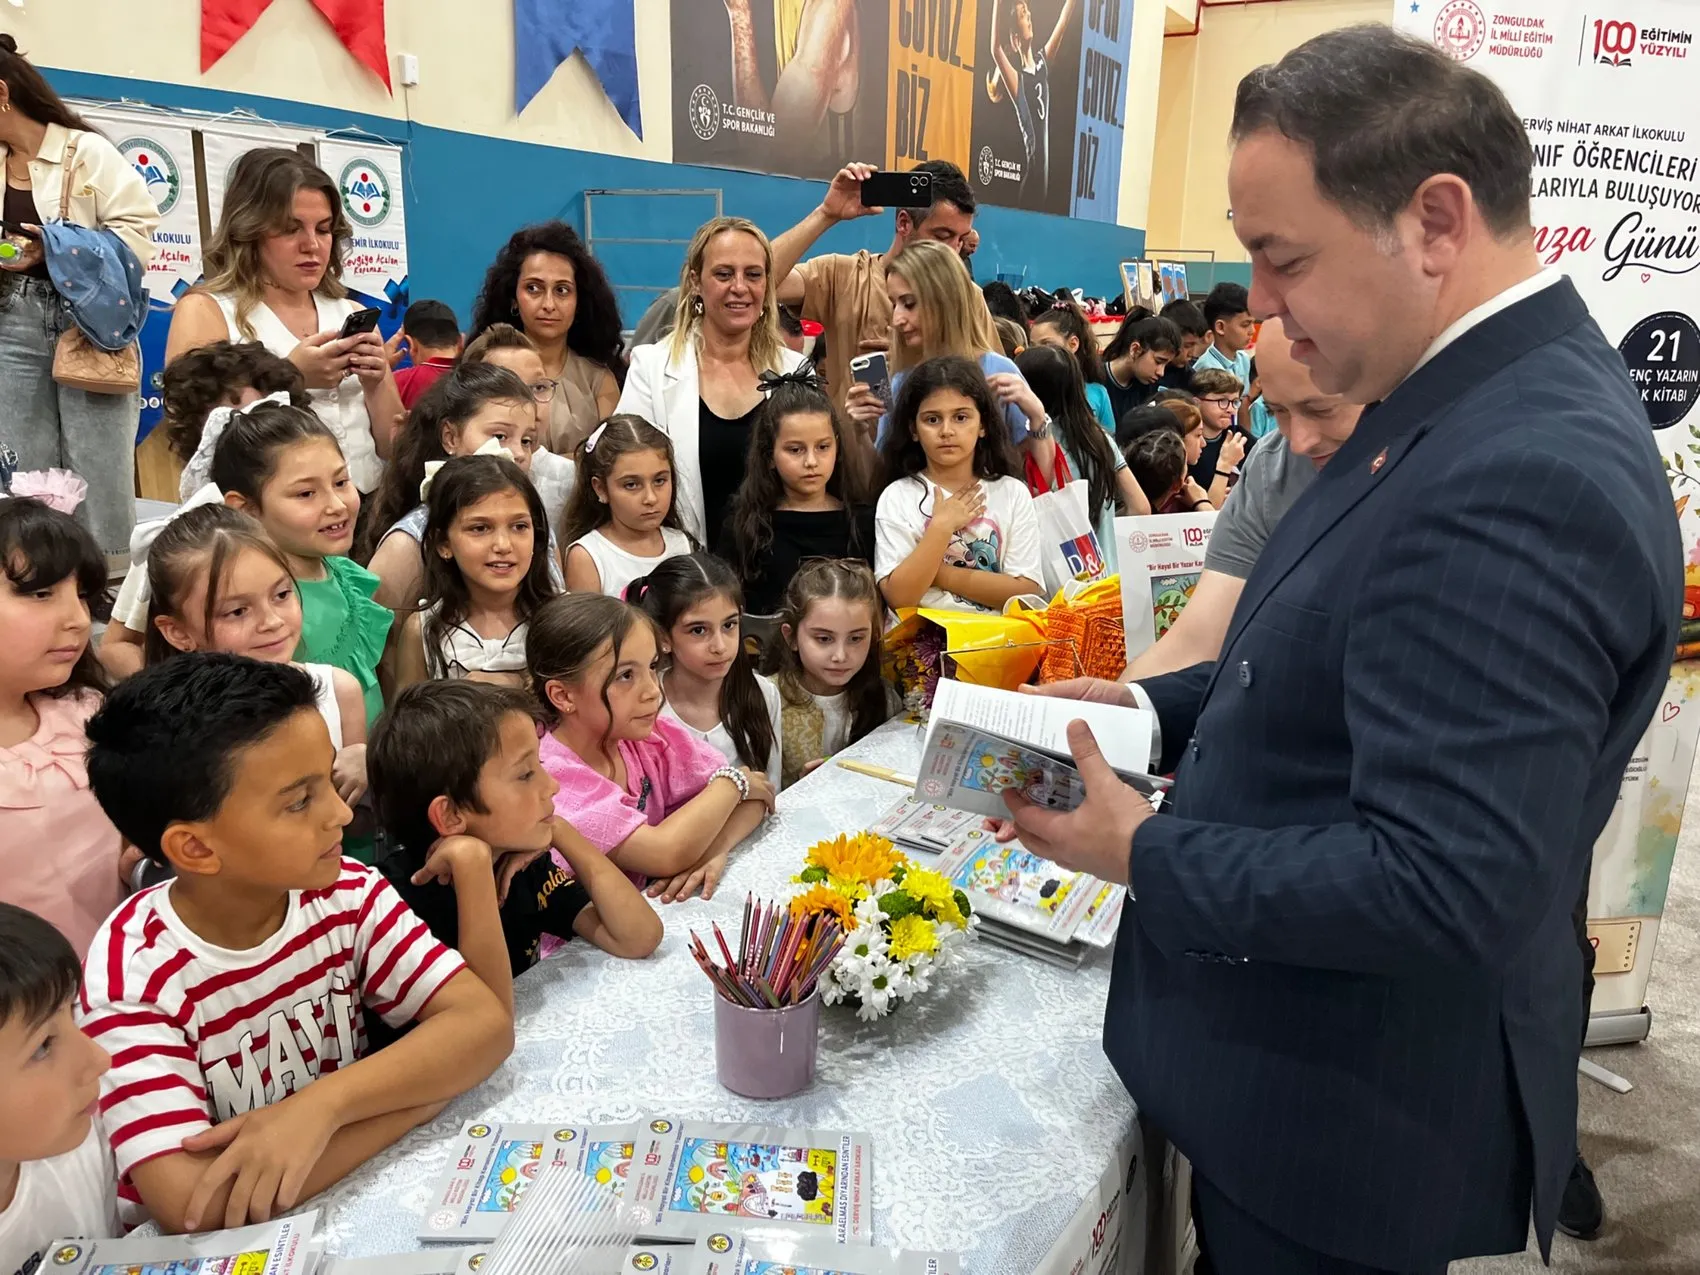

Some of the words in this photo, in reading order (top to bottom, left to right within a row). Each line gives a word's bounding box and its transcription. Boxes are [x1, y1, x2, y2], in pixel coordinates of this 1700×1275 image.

[1492, 14, 1545, 28] ZONGULDAK
[1490, 27, 1498, 40] İL
[1500, 28, 1522, 42] MİLLİ
[1523, 30, 1553, 44] EĞİTİM
[1594, 18, 1637, 64] 100
[1640, 27, 1692, 44] EĞİTİMİN
[1488, 43, 1543, 59] MÜDÜRLÜĞÜ
[1639, 42, 1687, 58] YÜZYILI
[1035, 83, 1045, 120] 3
[722, 103, 735, 116] T.C.
[736, 106, 766, 122] GENÇLİK
[766, 111, 776, 124] VE
[896, 63, 931, 162] BİZ
[722, 117, 741, 131] SPOR
[741, 121, 776, 137] BAKANLIĞI
[1522, 117, 1553, 135] ERVİŞ
[1556, 119, 1592, 135] NİHAT
[1593, 123, 1630, 138] ARKAT
[1632, 125, 1686, 142] İLKOKULU
[1532, 143, 1565, 168] NIF
[1572, 139, 1699, 183] ÖĞRENCİLERİ
[151, 232, 192, 245] LKOKULU
[1602, 211, 1700, 282] Günü
[1646, 328, 1681, 362] 21
[1629, 368, 1653, 386] ENÇ
[1656, 368, 1699, 383] YAZARIN
[1652, 385, 1688, 402] KİTABI
[1182, 527, 1203, 546] 100
[837, 1201, 848, 1244] KARAELMAS
